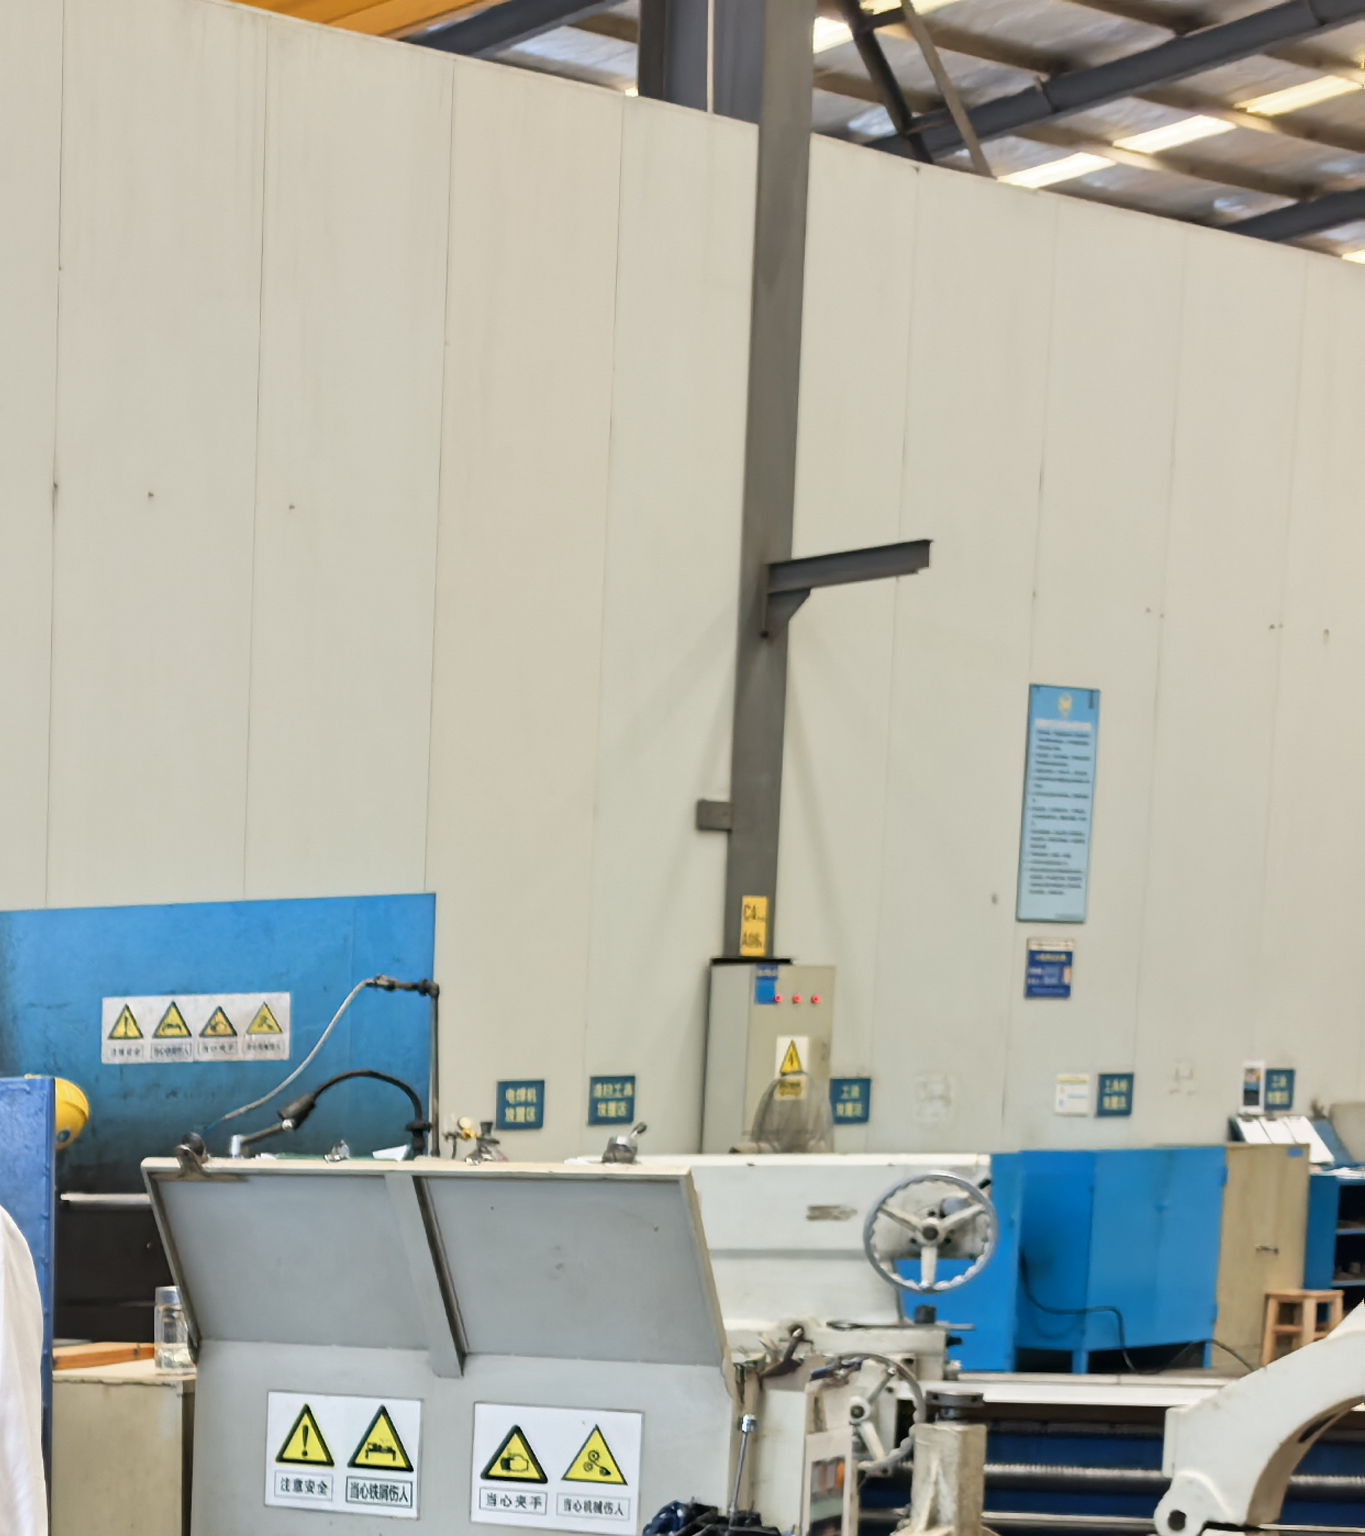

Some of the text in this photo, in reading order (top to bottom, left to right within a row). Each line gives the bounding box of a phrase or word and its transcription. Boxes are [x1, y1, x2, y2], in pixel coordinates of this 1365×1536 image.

[280, 1476, 329, 1496] 注意安全
[349, 1481, 410, 1505] 当心铁屑伤人
[484, 1491, 543, 1511] 当心夹手
